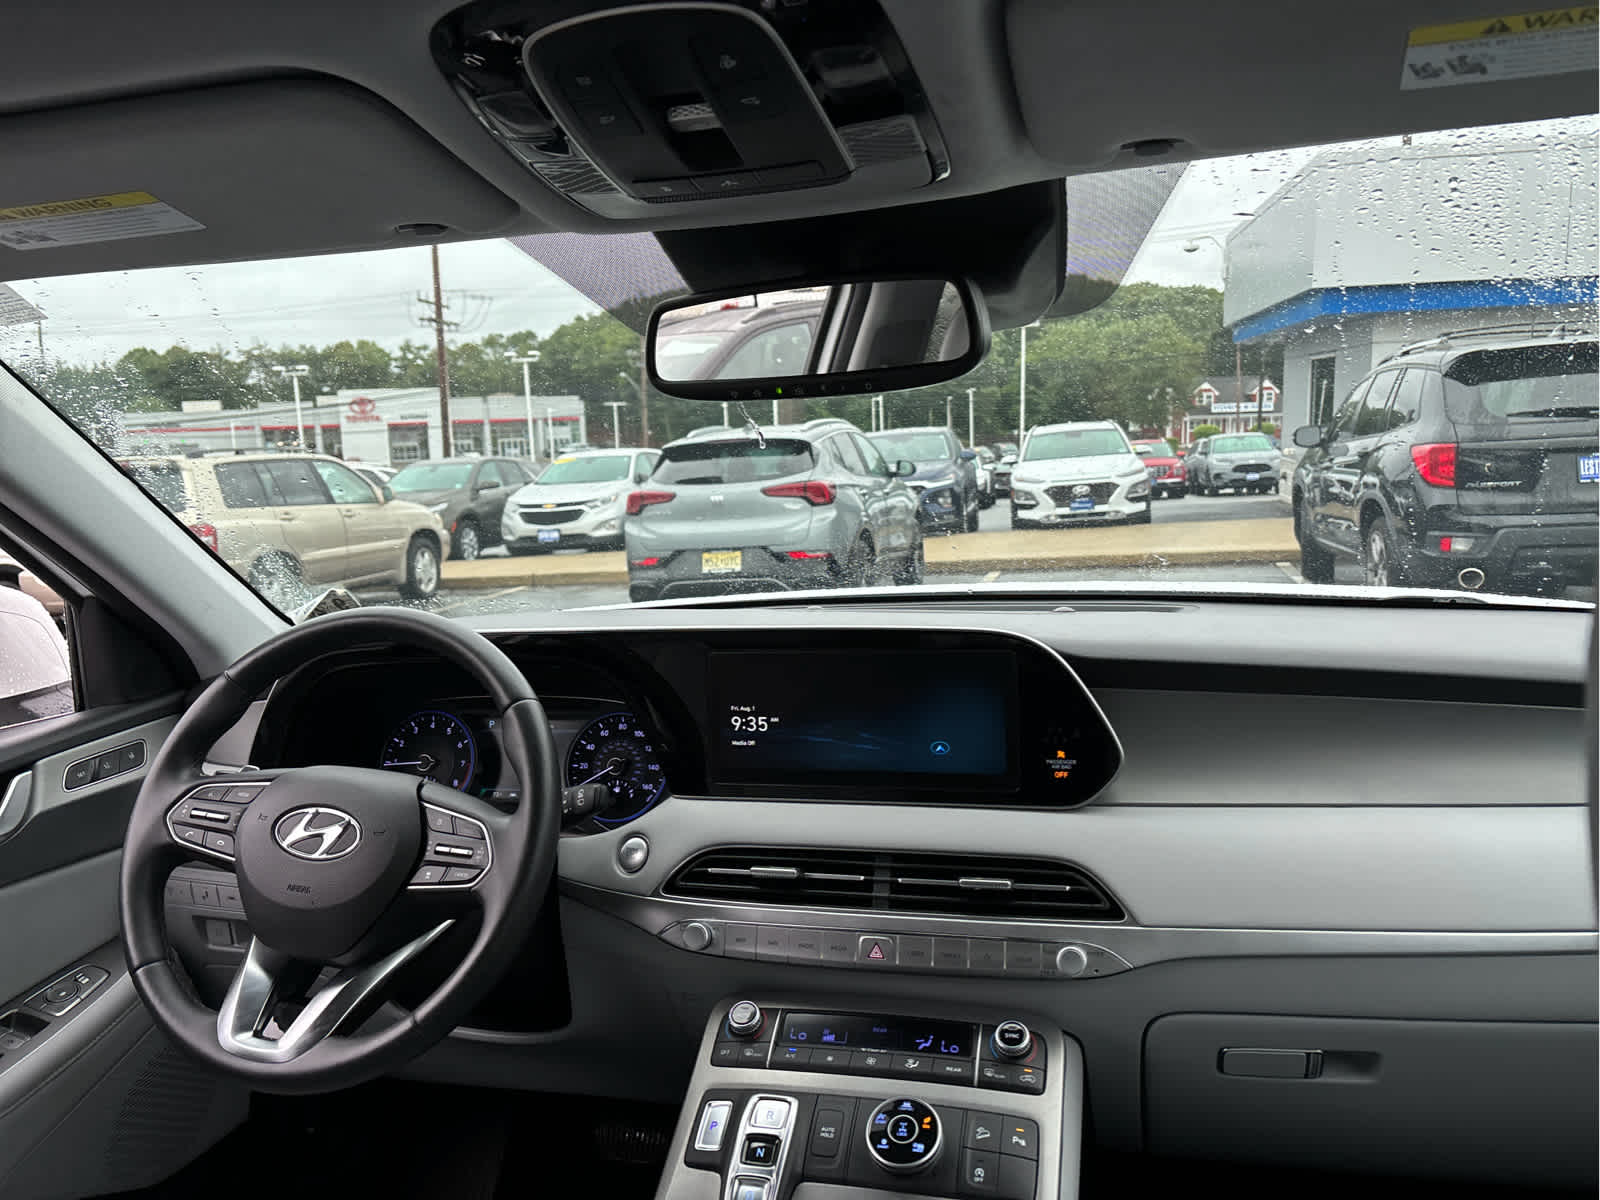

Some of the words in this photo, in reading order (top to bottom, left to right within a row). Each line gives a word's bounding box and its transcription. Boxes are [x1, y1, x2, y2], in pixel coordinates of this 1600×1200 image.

[17, 199, 113, 217] WARNING
[345, 415, 383, 423] TOYOTA
[488, 720, 495, 729] P
[731, 716, 768, 732] 9:35
[946, 1065, 962, 1073] REAR
[766, 1111, 775, 1121] R
[709, 1120, 719, 1131] P
[755, 1147, 765, 1158] N
